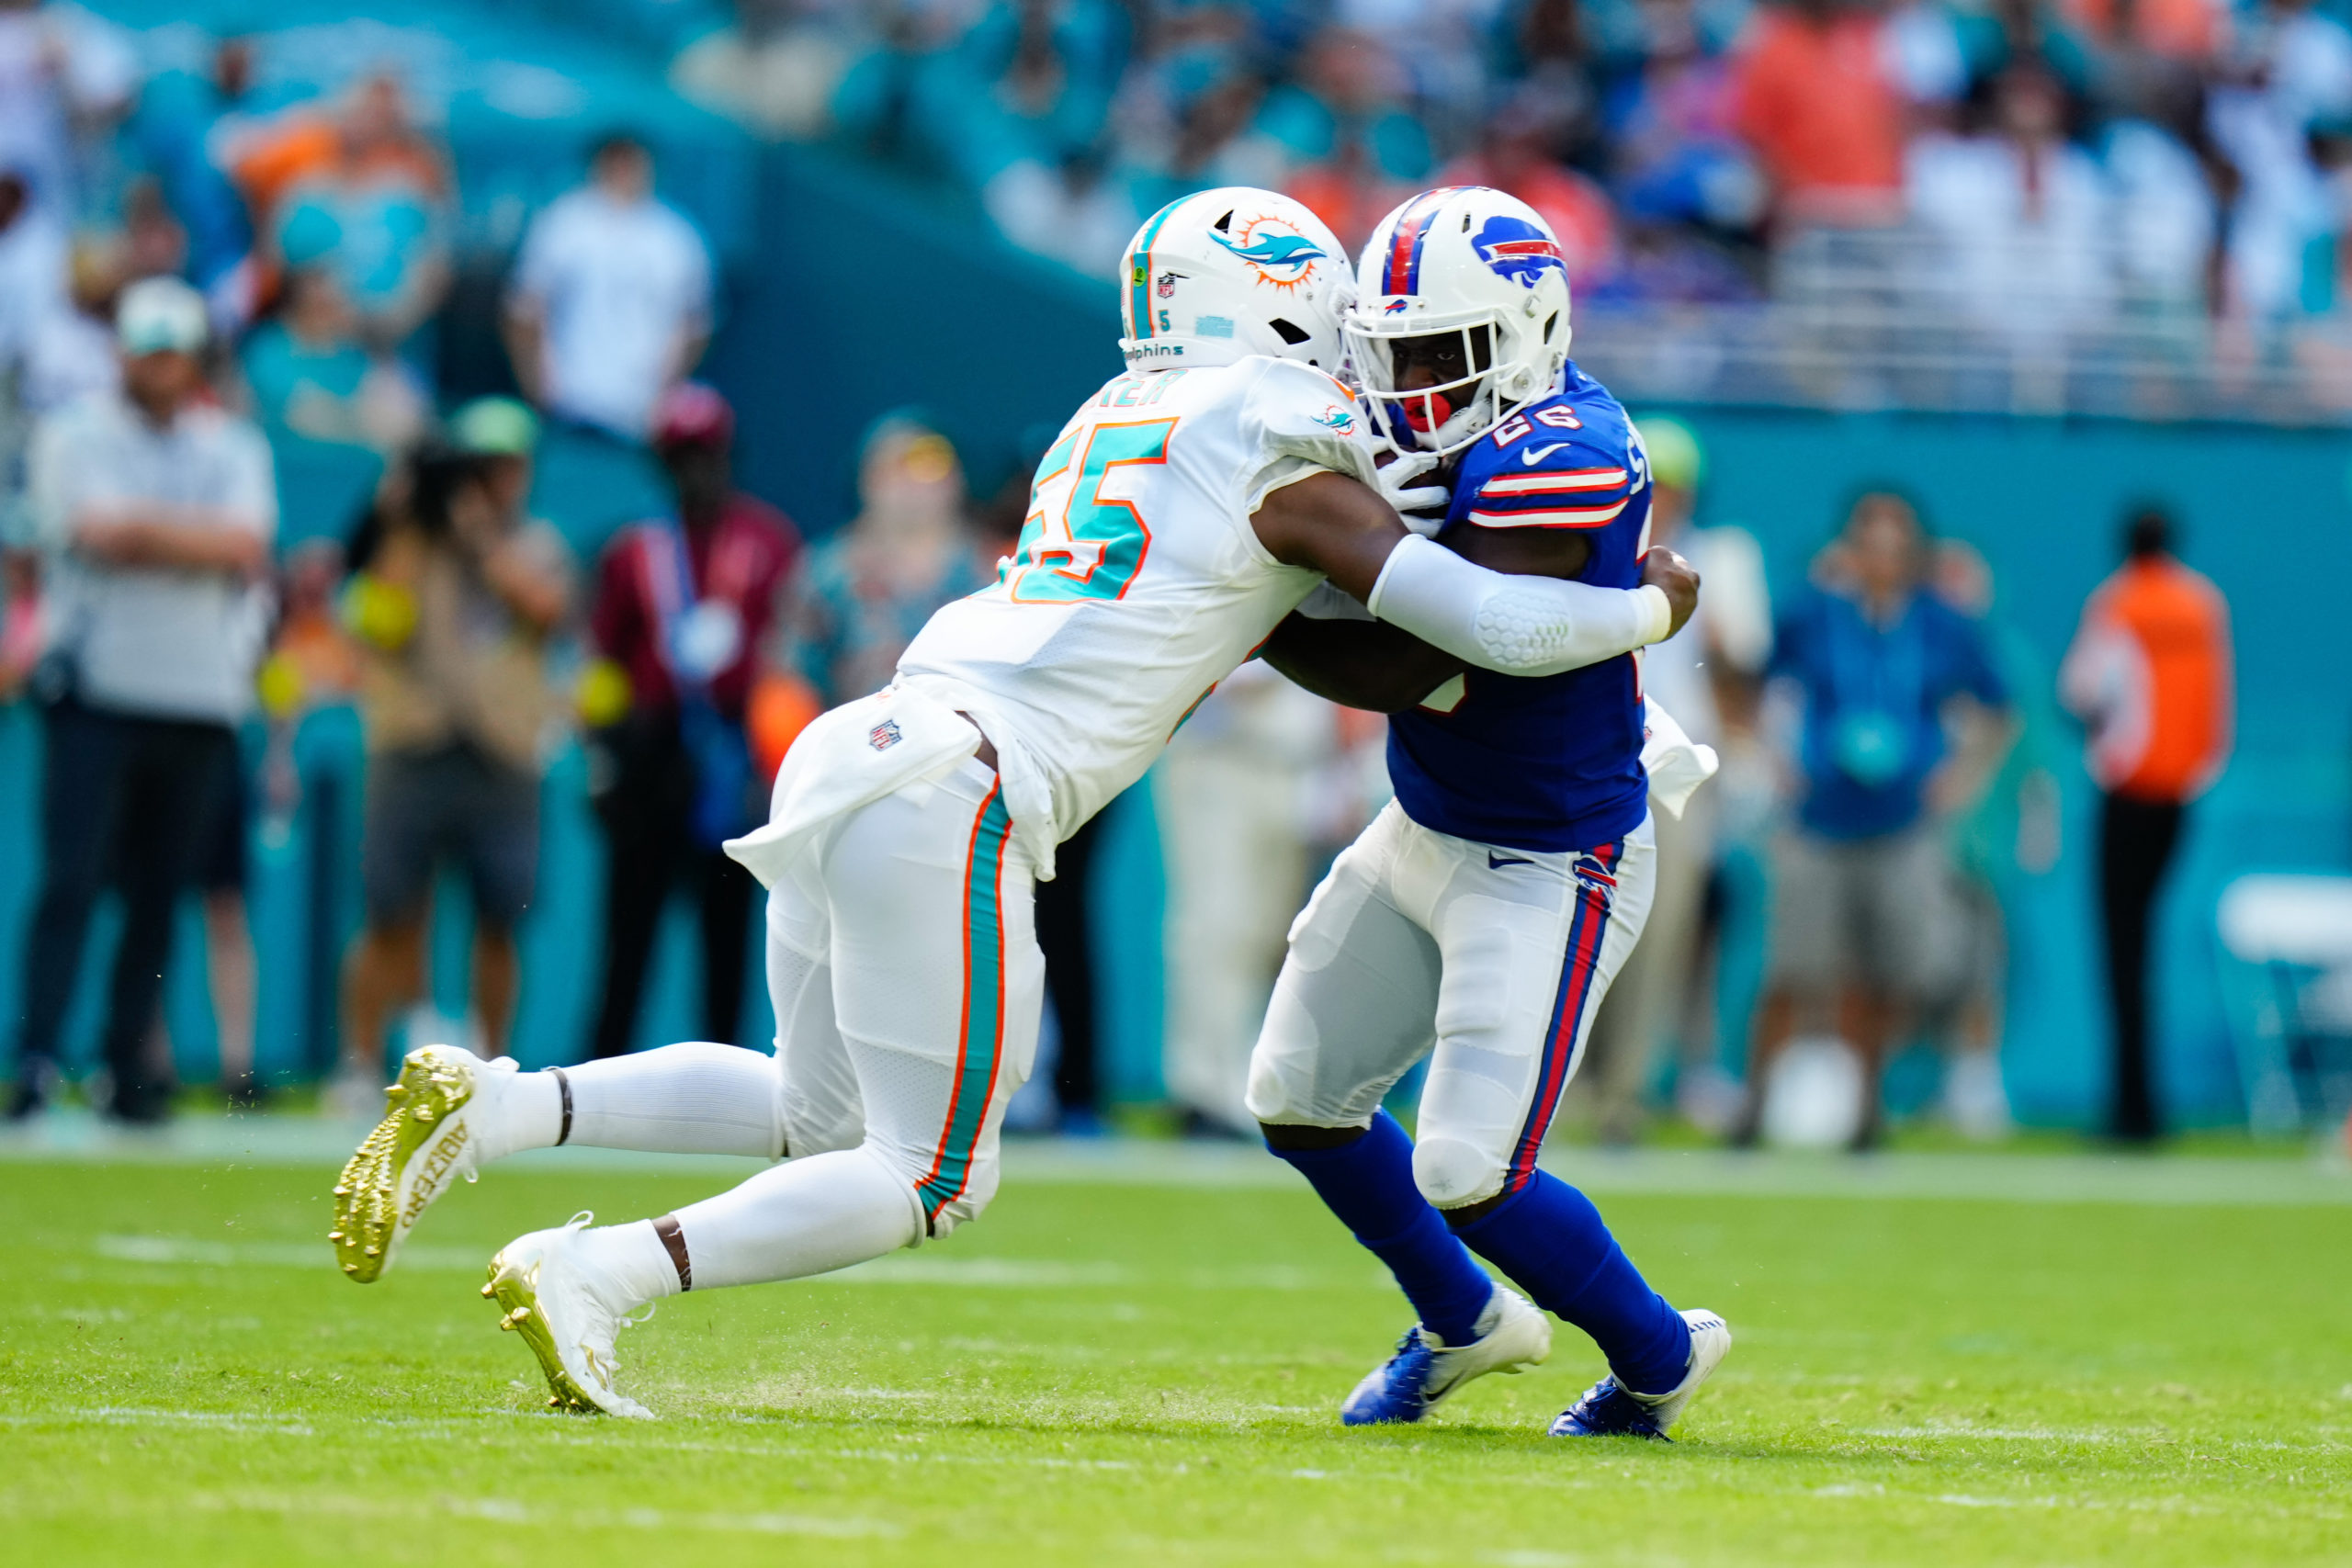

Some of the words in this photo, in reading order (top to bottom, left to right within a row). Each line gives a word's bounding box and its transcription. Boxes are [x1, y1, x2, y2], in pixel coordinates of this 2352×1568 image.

[1158, 309, 1170, 333] 5
[1491, 403, 1583, 449] 26
[966, 416, 1180, 604] 55
